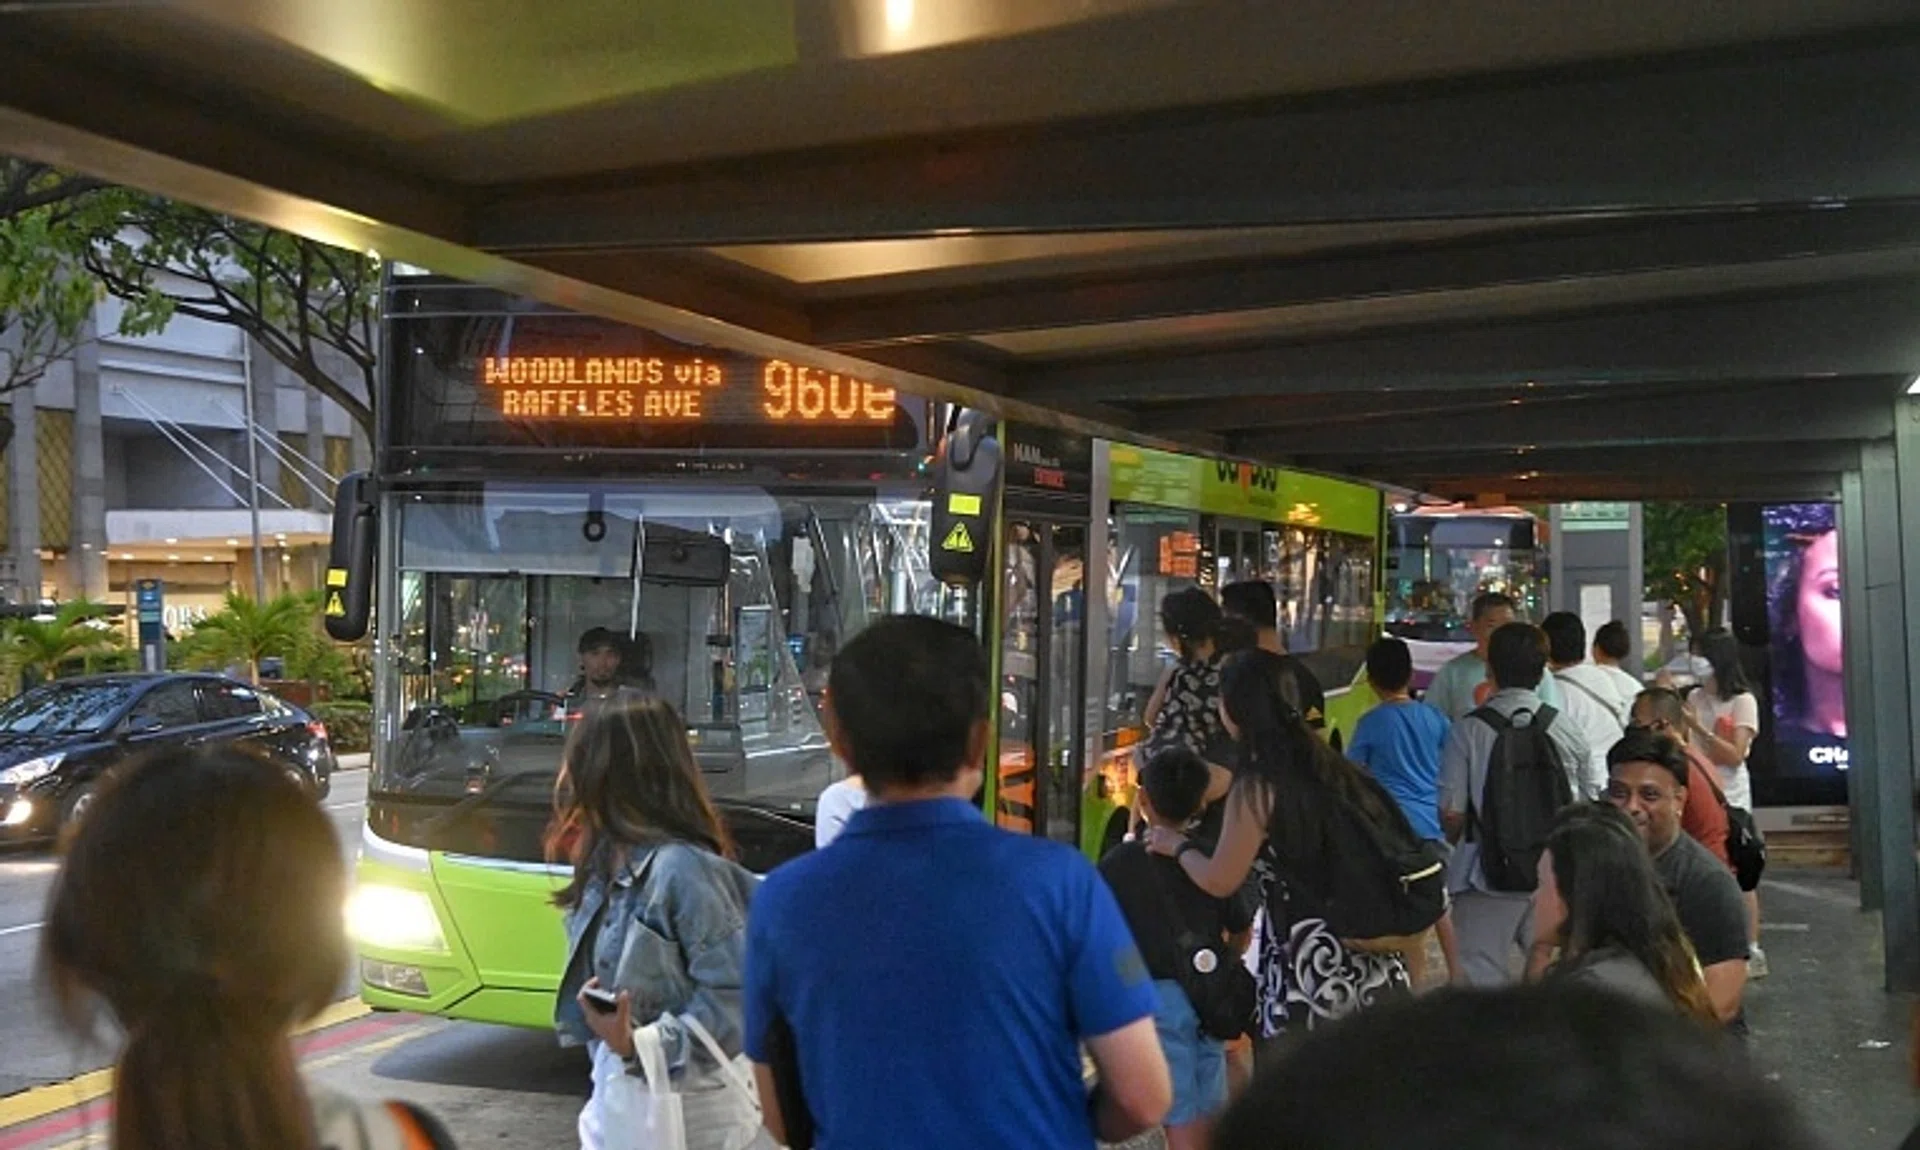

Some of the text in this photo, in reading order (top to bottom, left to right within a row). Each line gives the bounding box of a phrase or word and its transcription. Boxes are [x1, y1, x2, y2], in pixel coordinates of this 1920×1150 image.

[485, 357, 722, 385] WOODLANDS via
[502, 390, 702, 417] RAFFLES AVE
